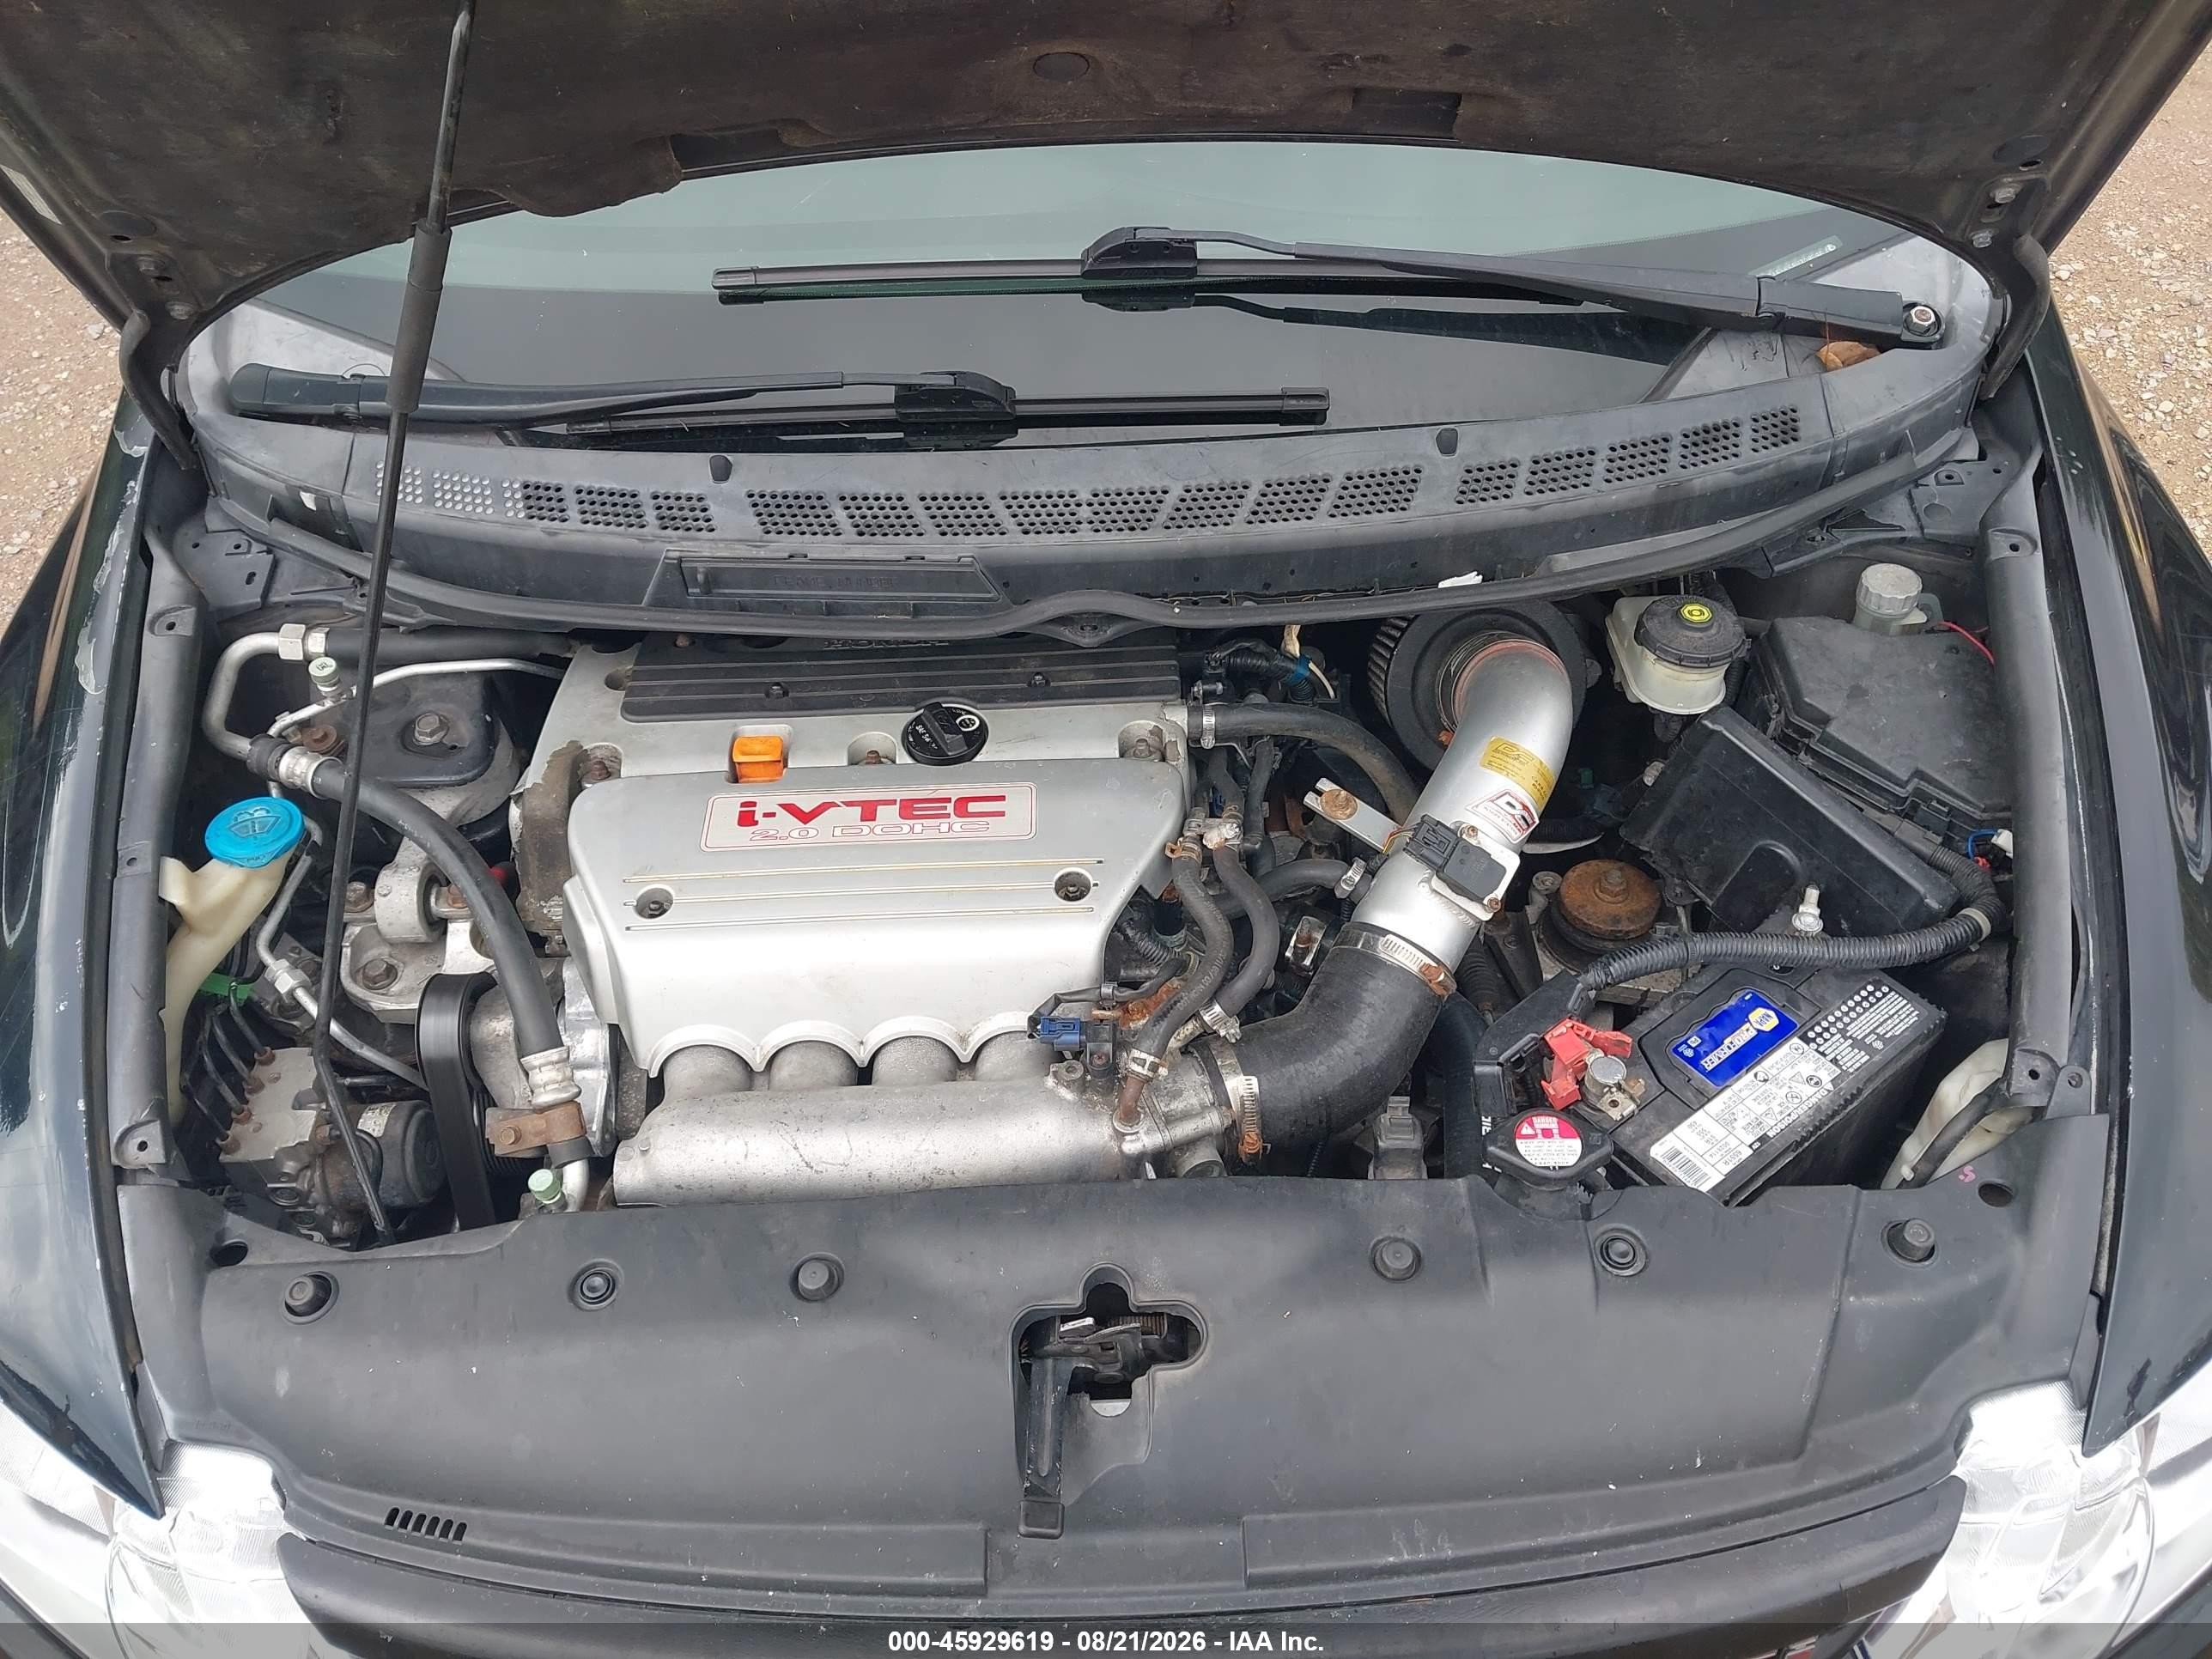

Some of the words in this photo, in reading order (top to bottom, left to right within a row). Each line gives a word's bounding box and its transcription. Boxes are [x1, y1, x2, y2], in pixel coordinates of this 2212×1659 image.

[737, 794, 1006, 828] i-VTEC
[750, 825, 819, 842] 2.0
[833, 820, 991, 838] DOHC
[1753, 1011, 1774, 1029] NAPA
[1765, 1087, 1828, 1138] DANGER/POISON
